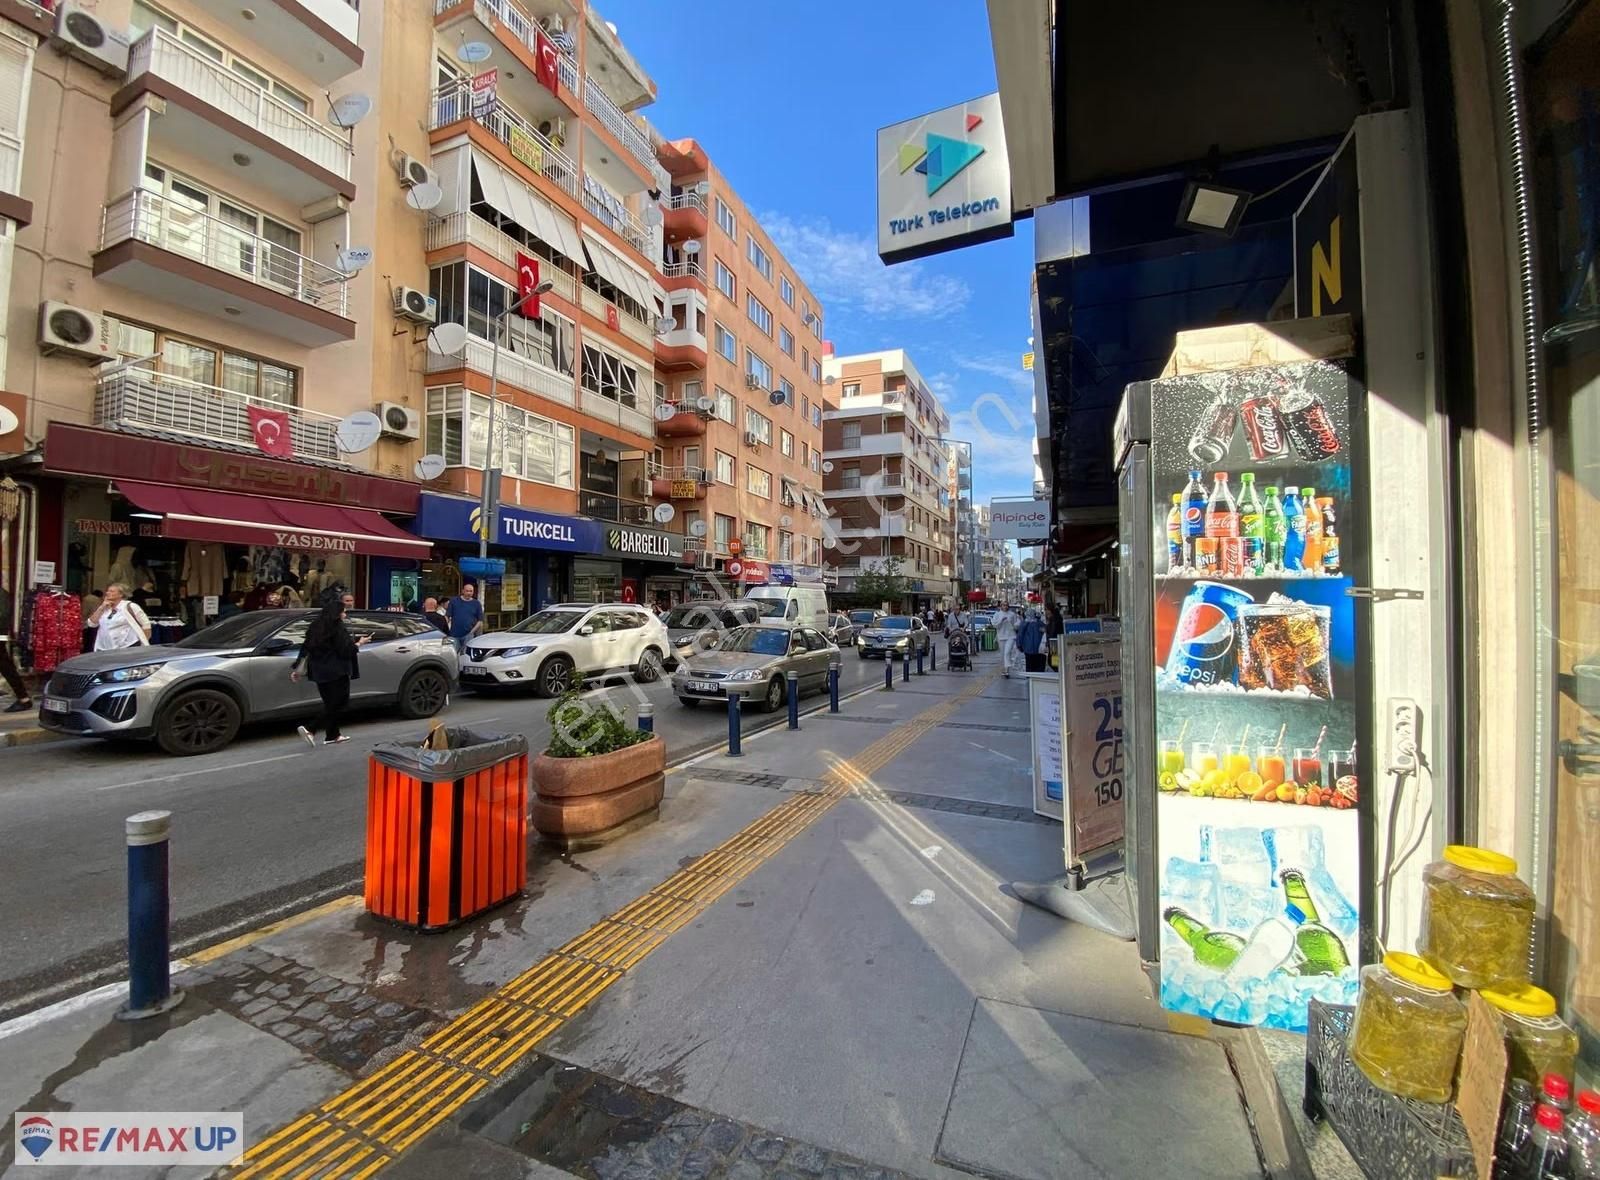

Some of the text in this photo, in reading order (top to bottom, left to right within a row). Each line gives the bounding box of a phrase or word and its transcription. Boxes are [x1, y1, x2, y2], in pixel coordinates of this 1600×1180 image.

[889, 196, 1000, 235] Türk Telekom
[79, 519, 131, 535] TAKIM
[992, 511, 1046, 525] Alpinde
[503, 517, 575, 542] TURKCELL
[274, 532, 356, 551] YASEMİN
[621, 530, 669, 557] BARGELLO
